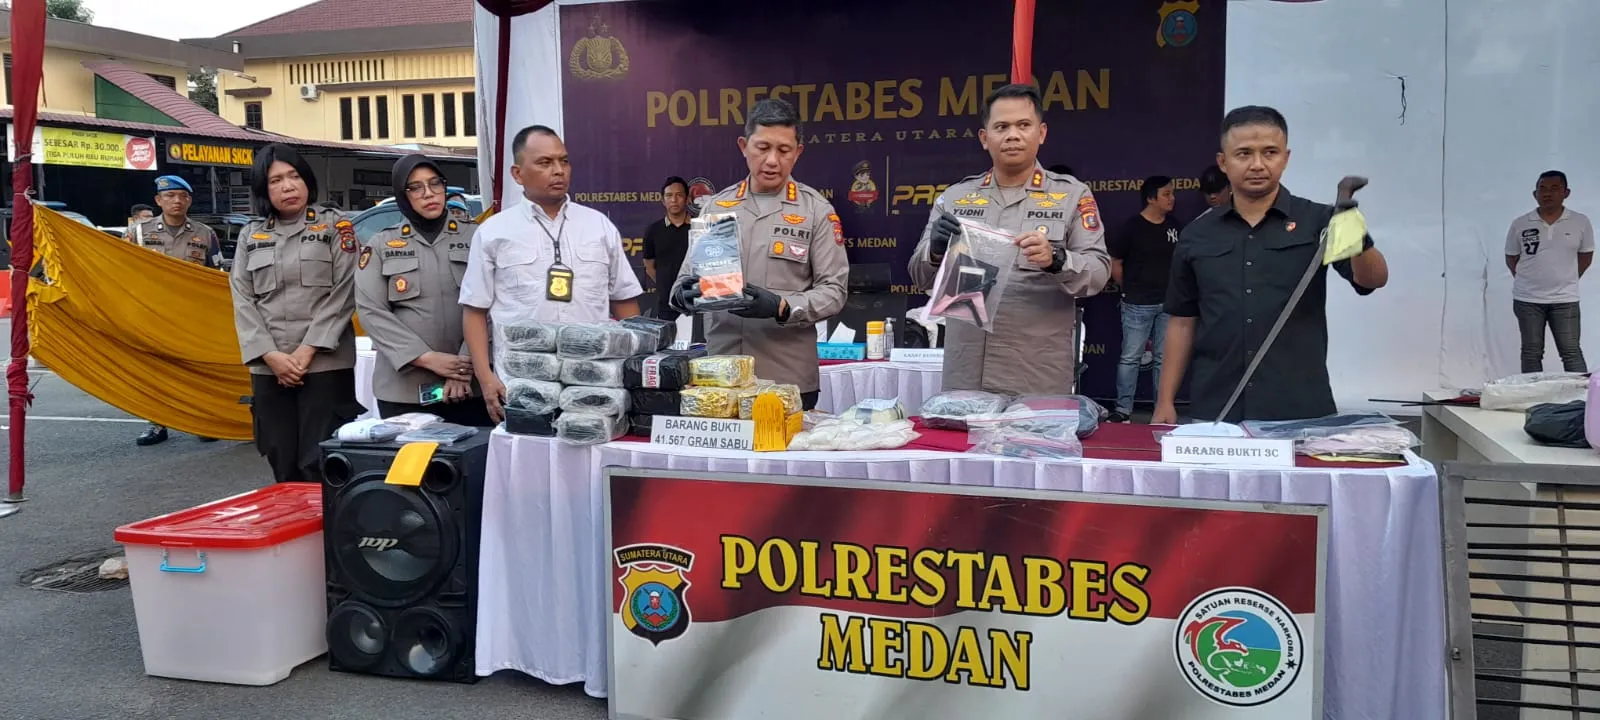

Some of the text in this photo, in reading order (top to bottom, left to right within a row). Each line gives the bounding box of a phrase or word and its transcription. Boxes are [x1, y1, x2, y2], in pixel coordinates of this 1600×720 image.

[896, 128, 976, 141] UTARA
[44, 139, 79, 148] SEBESAR
[182, 143, 254, 165] PELAYANAN SKCK
[575, 192, 662, 202] POLRESTABES MED
[953, 209, 984, 217] YUDHI
[1027, 211, 1063, 219] POLRI
[301, 234, 331, 244] POLRI
[774, 227, 810, 239] POLRI
[857, 237, 896, 248] MEDAN
[1524, 242, 1540, 255] 27
[665, 419, 741, 432] BARANG BUKTI
[655, 434, 749, 449] 41.567 GRAM SABU
[1176, 446, 1279, 458] BARANG BUKTI 3C
[620, 549, 688, 565] SUMATERA UTARA
[720, 534, 1151, 625] POLRESTABES
[1195, 597, 1294, 658] SATUAN RESERSE NARKOBA
[817, 613, 1032, 690] MEDAN
[1188, 661, 1286, 697] POLRESTABES MEDAN
